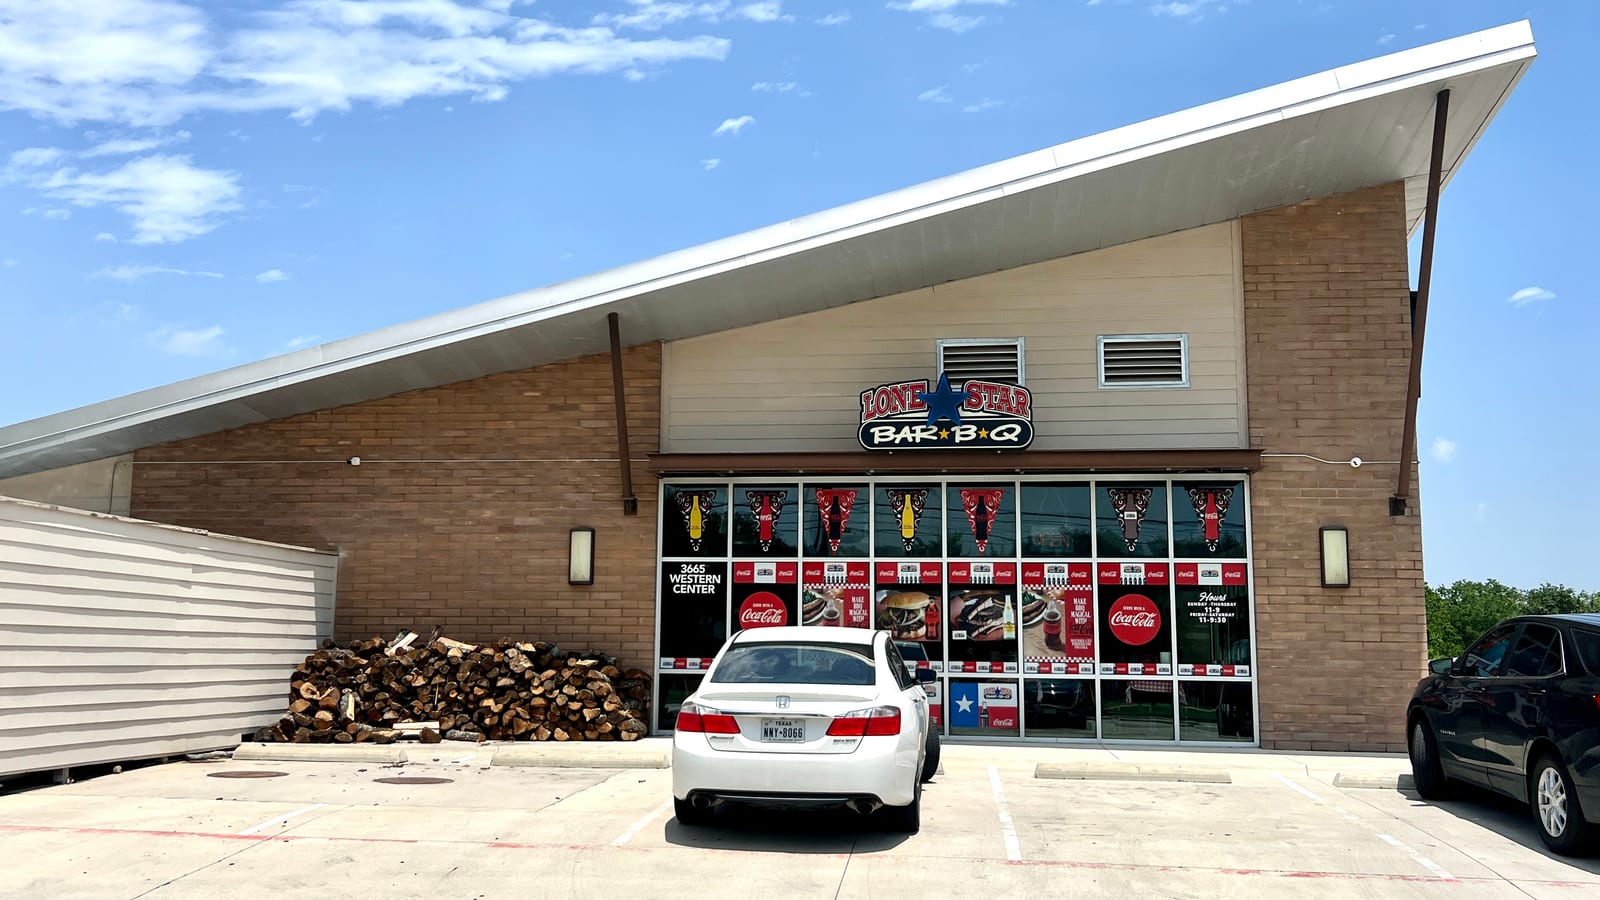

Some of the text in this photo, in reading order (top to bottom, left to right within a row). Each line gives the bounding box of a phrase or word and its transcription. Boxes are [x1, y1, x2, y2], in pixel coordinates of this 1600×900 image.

[863, 381, 1030, 420] LONE STAR
[870, 425, 938, 444] BAR
[680, 564, 706, 574] 3665
[669, 574, 721, 584] WESTERN
[672, 584, 716, 594] CENTER
[1199, 592, 1227, 601] Hours
[741, 608, 785, 623] Coca-Cola
[1111, 611, 1157, 627] Coca-Cola
